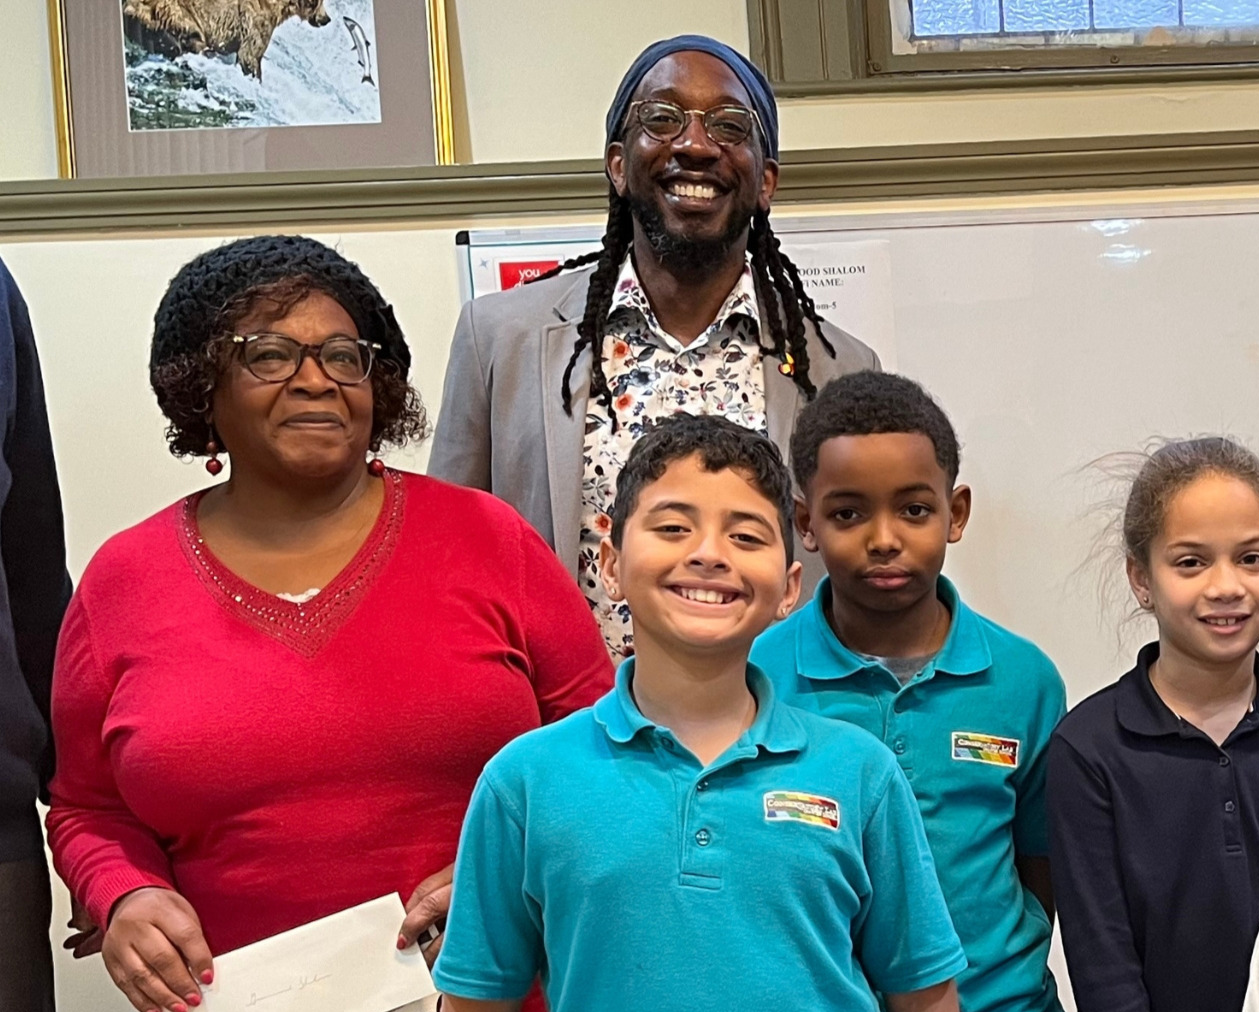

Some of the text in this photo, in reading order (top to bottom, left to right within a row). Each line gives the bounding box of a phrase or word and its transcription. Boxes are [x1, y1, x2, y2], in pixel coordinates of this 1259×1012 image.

[518, 269, 540, 280] you
[800, 266, 865, 276] OOD SHALOM
